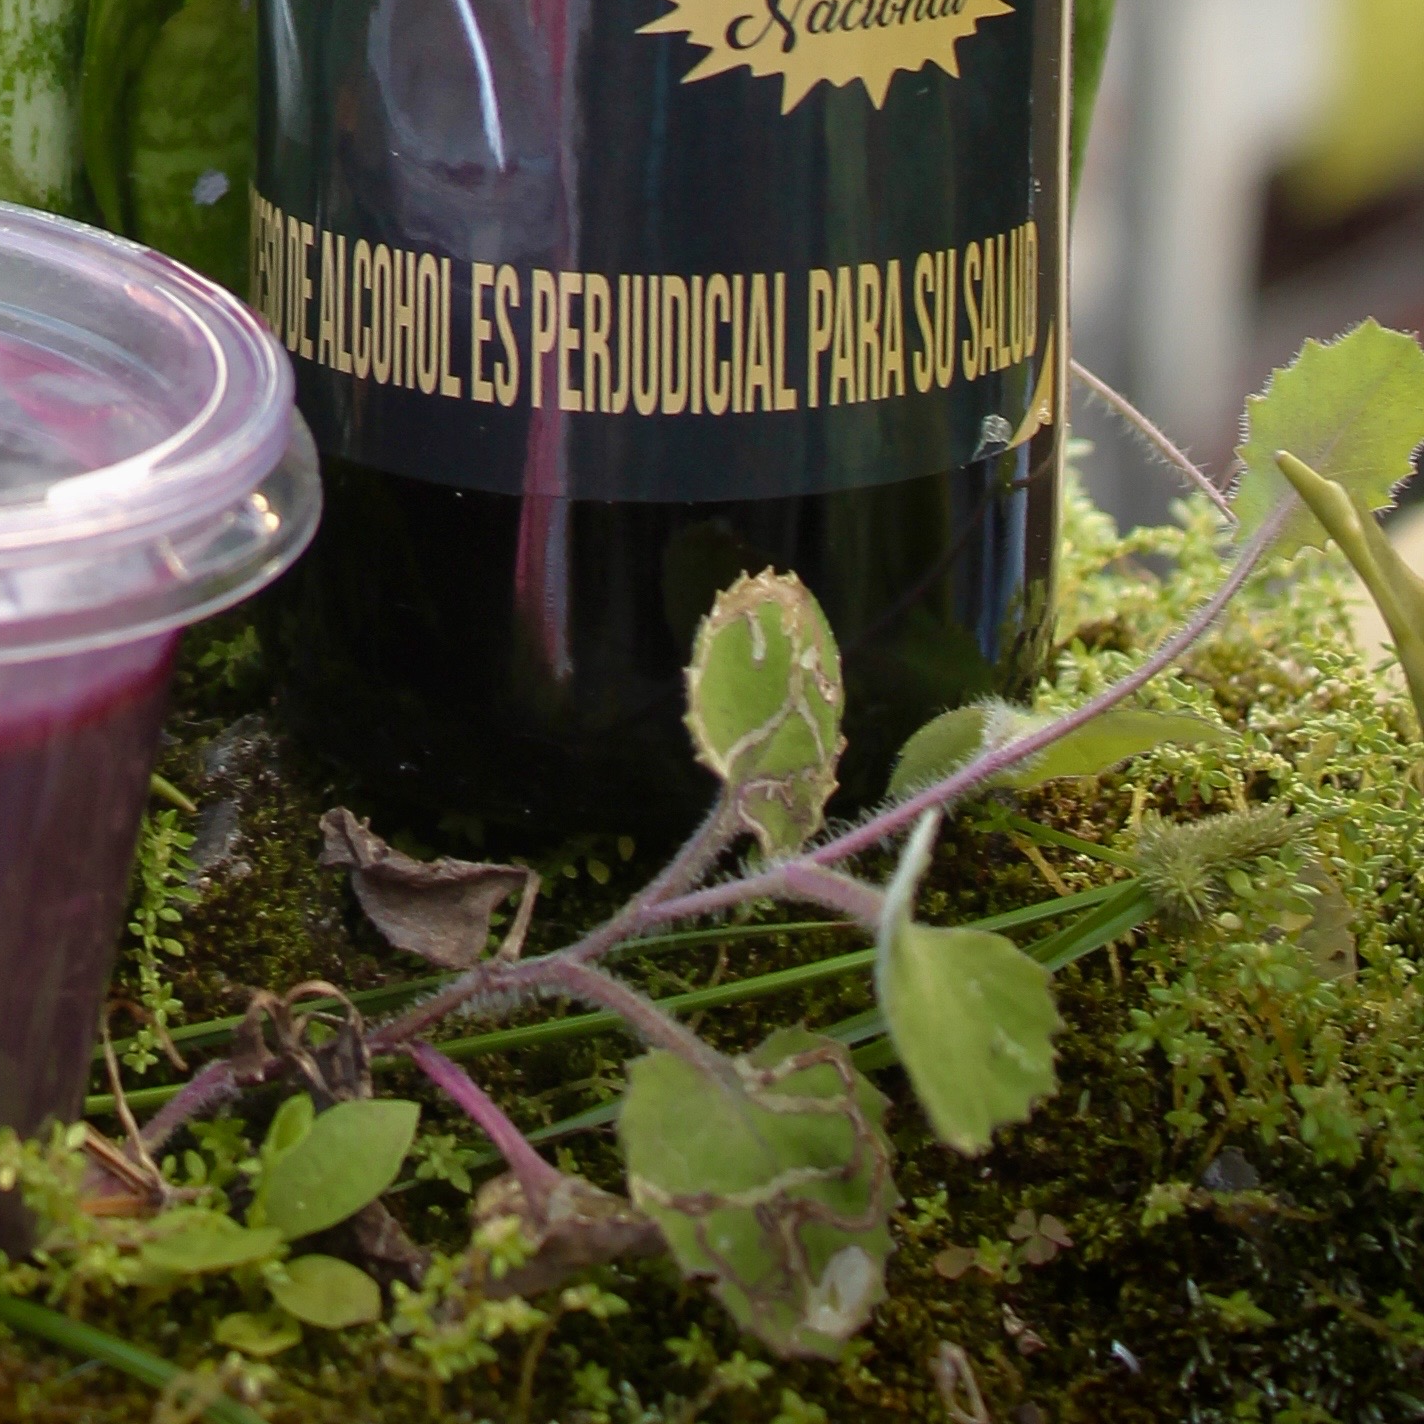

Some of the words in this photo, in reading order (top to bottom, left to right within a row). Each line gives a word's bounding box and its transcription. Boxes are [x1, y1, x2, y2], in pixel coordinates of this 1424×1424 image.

[287, 214, 314, 361] DE
[317, 229, 462, 399] ALCOHOL
[471, 261, 521, 407] ES
[531, 268, 798, 416] PERJUDICIAL
[807, 258, 906, 408] PARA
[913, 248, 957, 394] SU
[962, 220, 1038, 382] SALUD
